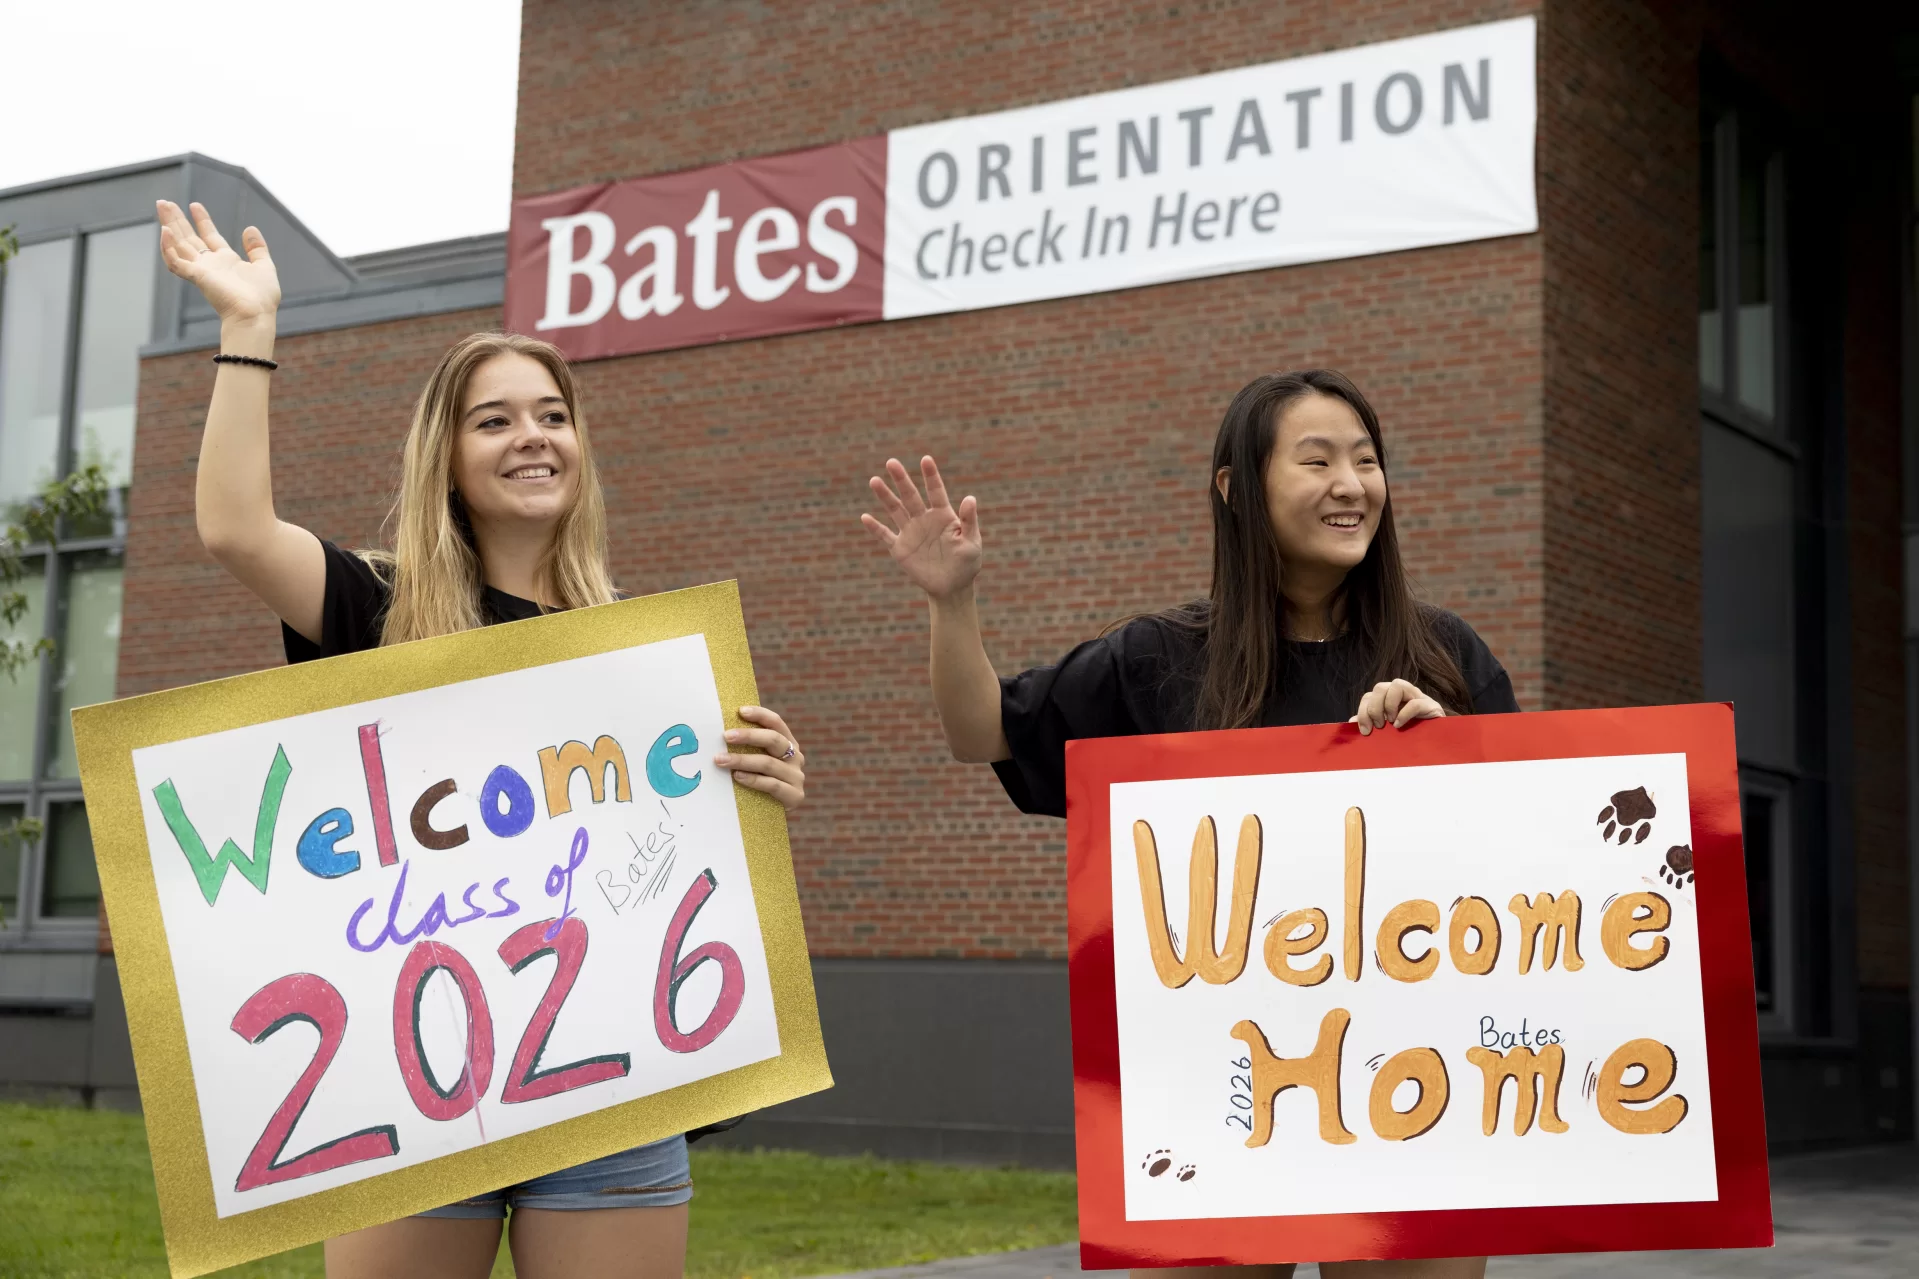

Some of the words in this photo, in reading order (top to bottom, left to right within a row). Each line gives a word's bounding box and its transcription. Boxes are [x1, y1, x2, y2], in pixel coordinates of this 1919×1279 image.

[917, 58, 1492, 208] ORIENTATION
[536, 189, 859, 331] Bates
[915, 208, 1067, 281] Check
[1081, 206, 1131, 259] In
[1148, 190, 1282, 249] Here
[151, 721, 702, 907] Welcome
[544, 827, 589, 941] of
[595, 799, 685, 916] Bates!
[1132, 806, 1672, 990] Welcome
[230, 867, 746, 1193] 2026
[1225, 1055, 1253, 1132] 2026
[1229, 1007, 1689, 1148] Home
[1479, 1015, 1564, 1050] Bates
